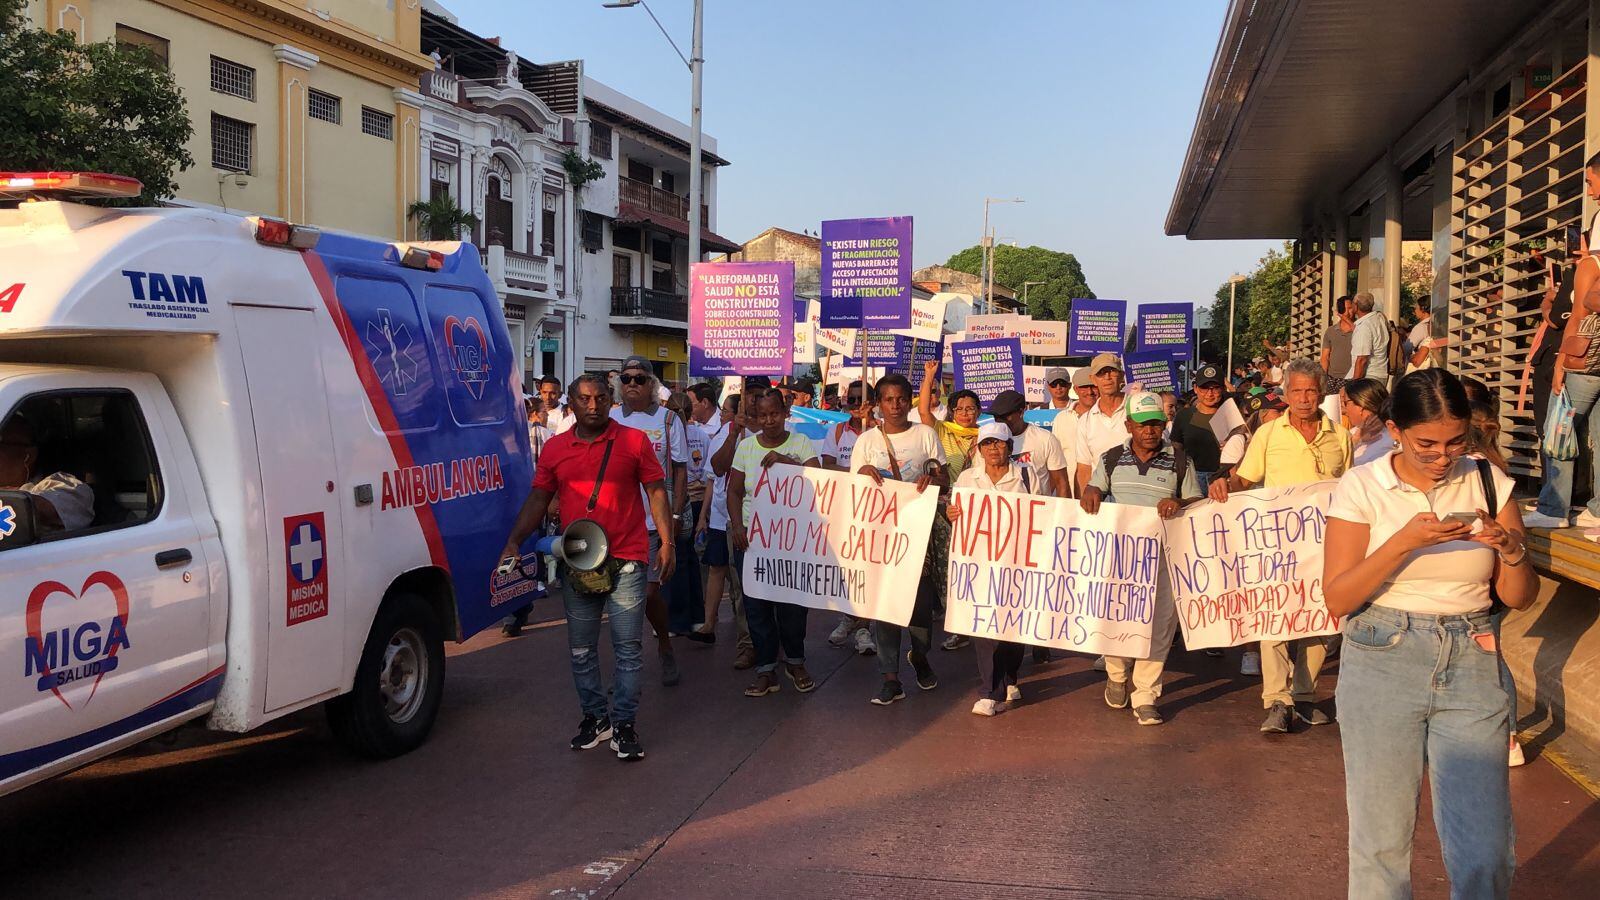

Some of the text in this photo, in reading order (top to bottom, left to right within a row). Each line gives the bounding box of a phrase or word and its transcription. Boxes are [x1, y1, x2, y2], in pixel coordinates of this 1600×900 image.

[857, 239, 869, 248] UN
[870, 238, 898, 248] RIESGO
[832, 248, 900, 259] DE FRAGMENTACIÓN,
[832, 260, 856, 268] NUEVAS
[857, 259, 889, 267] BARRERAS
[832, 269, 855, 278] ACCESO
[861, 267, 898, 276] AFECTACIÓN
[715, 274, 756, 284] REFORMA
[757, 274, 768, 283] DE
[769, 274, 779, 283] LA
[832, 277, 898, 287] EN LA INTEGRALIDAD
[121, 269, 207, 304] TAM
[705, 283, 780, 297] SALUD NO ESTÁ
[832, 288, 843, 298] DE
[843, 288, 854, 297] LA
[128, 302, 210, 313] TRASLADO ASISTENCIAL
[704, 298, 779, 308] CONSTRUYENDO
[146, 311, 197, 319] MEDICALIZADO
[704, 310, 726, 318] SOBRE
[735, 309, 781, 317] CONSTRUIDO.
[705, 319, 725, 327] TODO
[725, 319, 735, 327] LO
[704, 328, 779, 338] ESTÁ DESTRUYENDO
[712, 339, 744, 347] SISTEMA
[744, 339, 755, 347] DE
[755, 339, 778, 347] SALUD
[704, 349, 722, 358] QUE
[981, 353, 997, 362] NO
[381, 453, 504, 511] AMBULANCIA
[754, 467, 898, 527] AMO MI VIDA
[749, 511, 909, 567] AMO MI SALUD
[951, 491, 1160, 585] NADIE RESPONDERÁ
[1189, 513, 1230, 559] LA
[1174, 551, 1299, 596] NO MEJORA
[291, 581, 323, 601] MISIÓN
[950, 560, 979, 602] POR
[987, 566, 1075, 615] NOSOTROS
[1086, 581, 1155, 625] NUESTRAS
[1187, 583, 1290, 631] OPORTUNIDAD
[1292, 579, 1305, 605] Y
[972, 605, 1087, 645] FAMILIAS
[1228, 604, 1341, 646] DE ATENCIÓN
[25, 616, 130, 677] MIGA
[56, 661, 101, 686] SALUD
